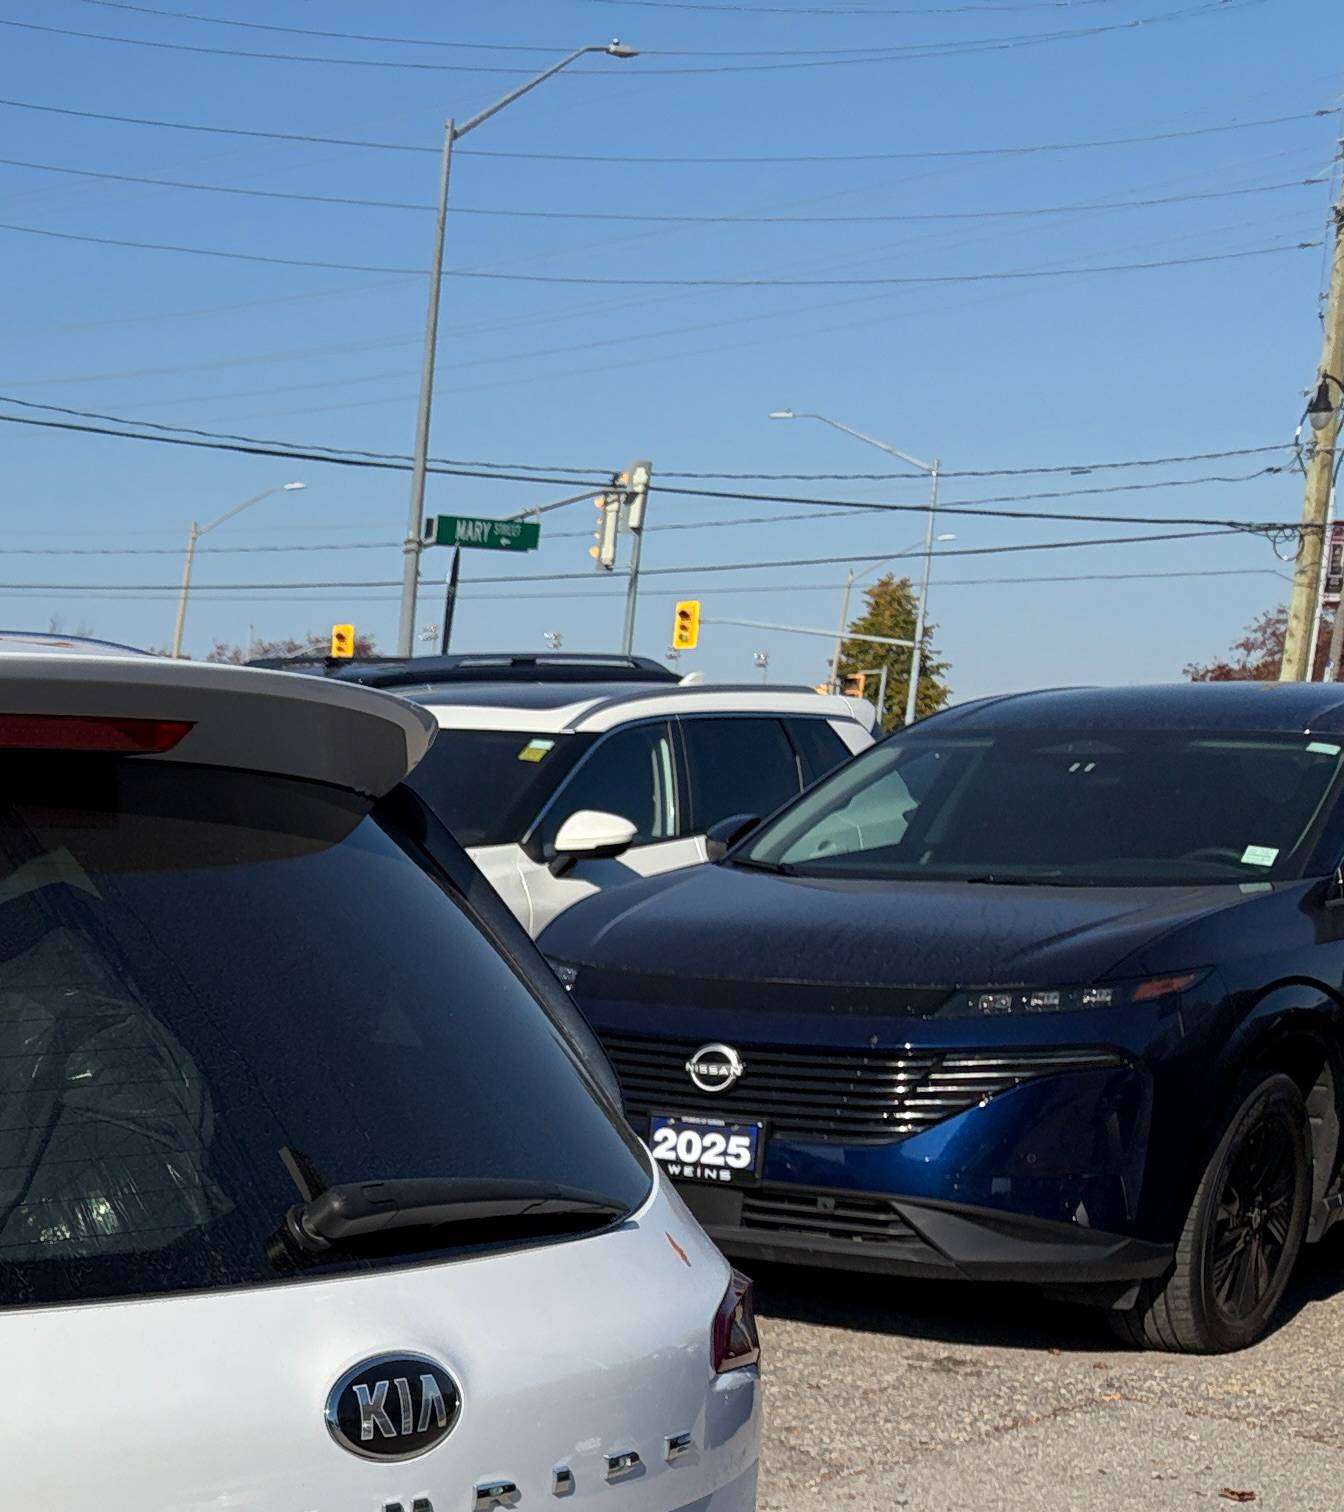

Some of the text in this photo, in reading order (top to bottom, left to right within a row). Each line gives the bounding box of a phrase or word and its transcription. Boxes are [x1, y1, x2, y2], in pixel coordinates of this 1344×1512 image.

[456, 520, 491, 542] MARY
[685, 1061, 743, 1077] NISSAN
[652, 1127, 752, 1170] 2025
[667, 1163, 732, 1182] WEINS
[352, 1374, 447, 1441] KIA
